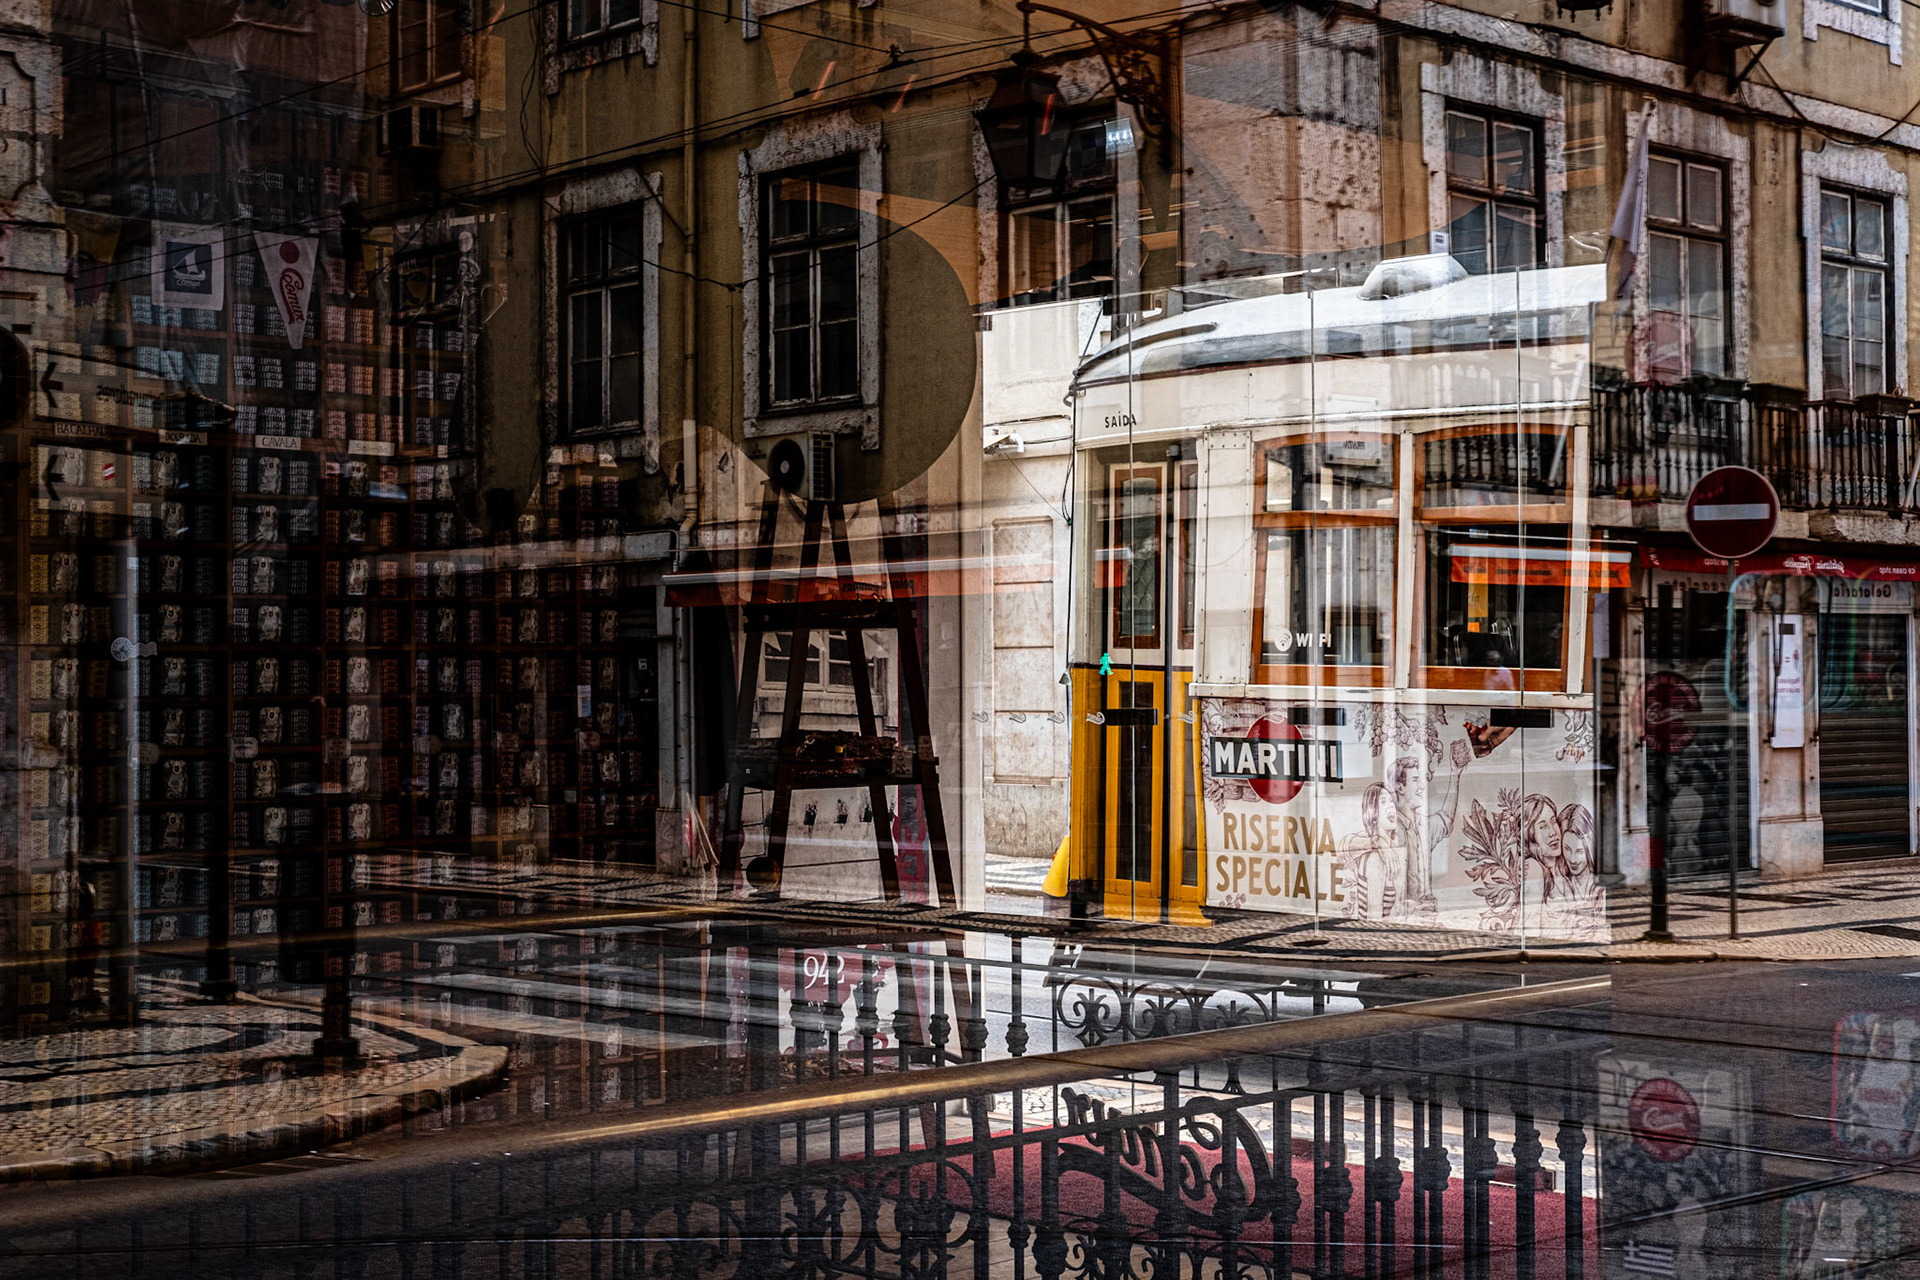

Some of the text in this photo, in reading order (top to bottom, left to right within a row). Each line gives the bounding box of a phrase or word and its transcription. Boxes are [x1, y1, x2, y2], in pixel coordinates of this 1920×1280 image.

[280, 267, 305, 325] Comur
[1104, 410, 1137, 428] SAÍDA
[262, 437, 298, 449] CAVALA
[1296, 633, 1313, 648] WI
[1213, 741, 1338, 779] MARTINI
[1223, 812, 1337, 857] RISERVA
[1216, 854, 1346, 902] SPECIALE
